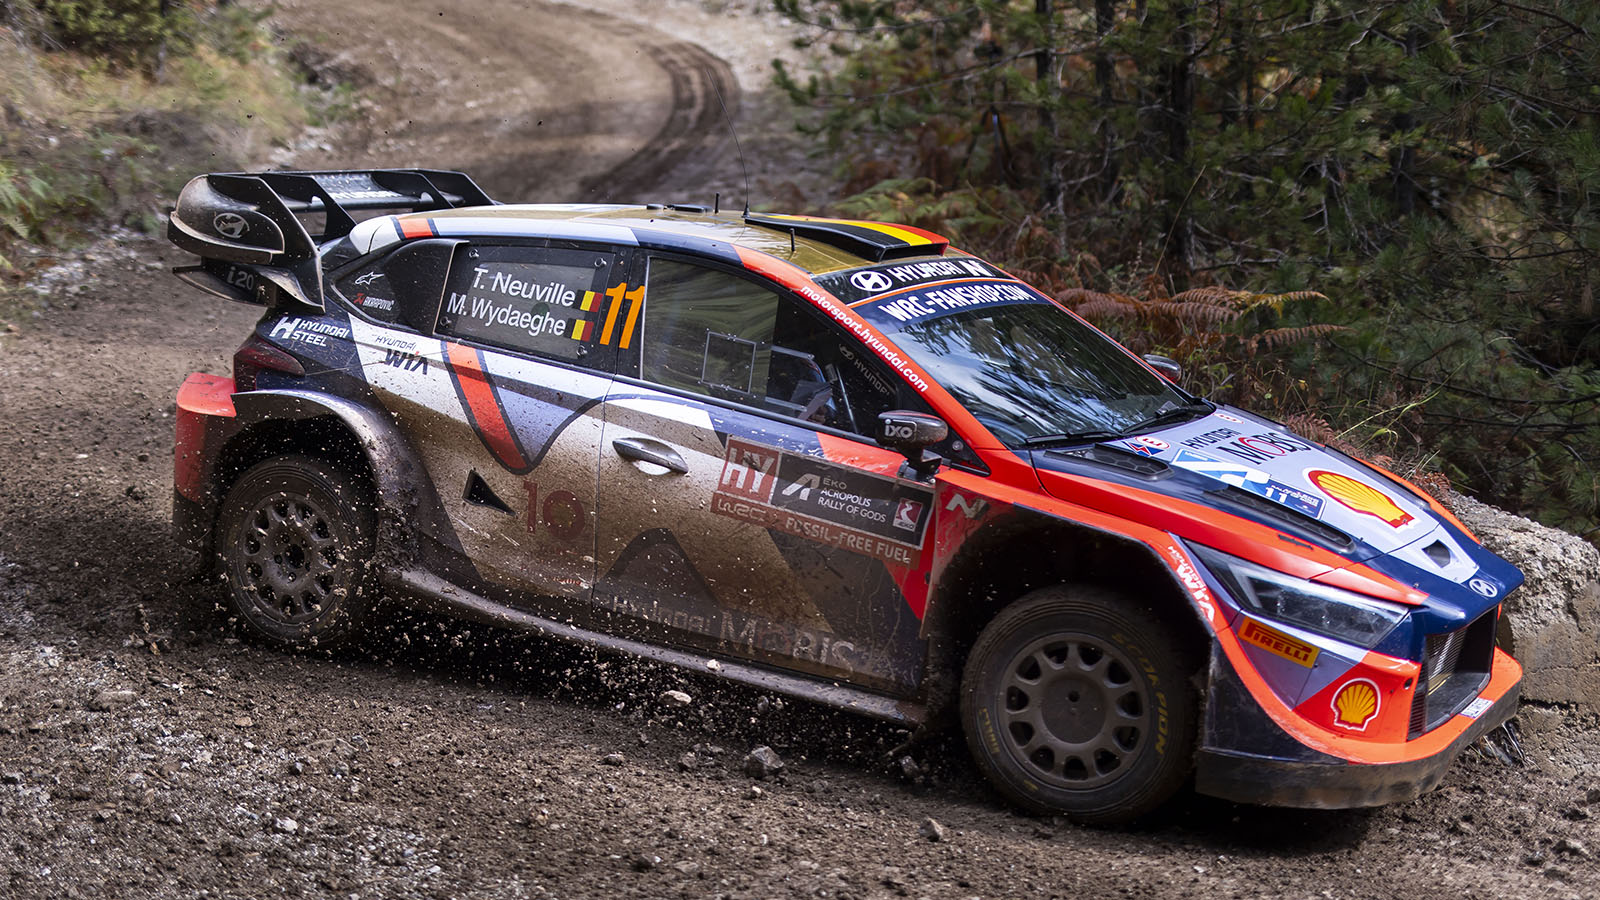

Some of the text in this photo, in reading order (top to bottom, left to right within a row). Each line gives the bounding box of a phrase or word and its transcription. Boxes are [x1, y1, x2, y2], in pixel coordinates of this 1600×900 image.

[226, 266, 254, 290] i20
[473, 267, 576, 307] T. Neuville
[887, 261, 966, 283] HYUNDAI
[446, 292, 566, 337] M. Wydaeghe
[600, 282, 645, 349] 11
[878, 284, 1037, 321] WRC-FANSHOP.COM
[292, 331, 327, 347] STEEL
[298, 319, 350, 339] HYUNDAI
[375, 335, 417, 351] HYUNDAI
[800, 284, 929, 393] motorsport.hyundai.com
[1216, 432, 1311, 465] MOBIS
[817, 496, 887, 523] RALLY OF GODS
[820, 488, 872, 507] ACROPOLIS
[785, 517, 912, 564] FOSSIL-FREE FUEL
[1246, 621, 1313, 663] PIRELLI
